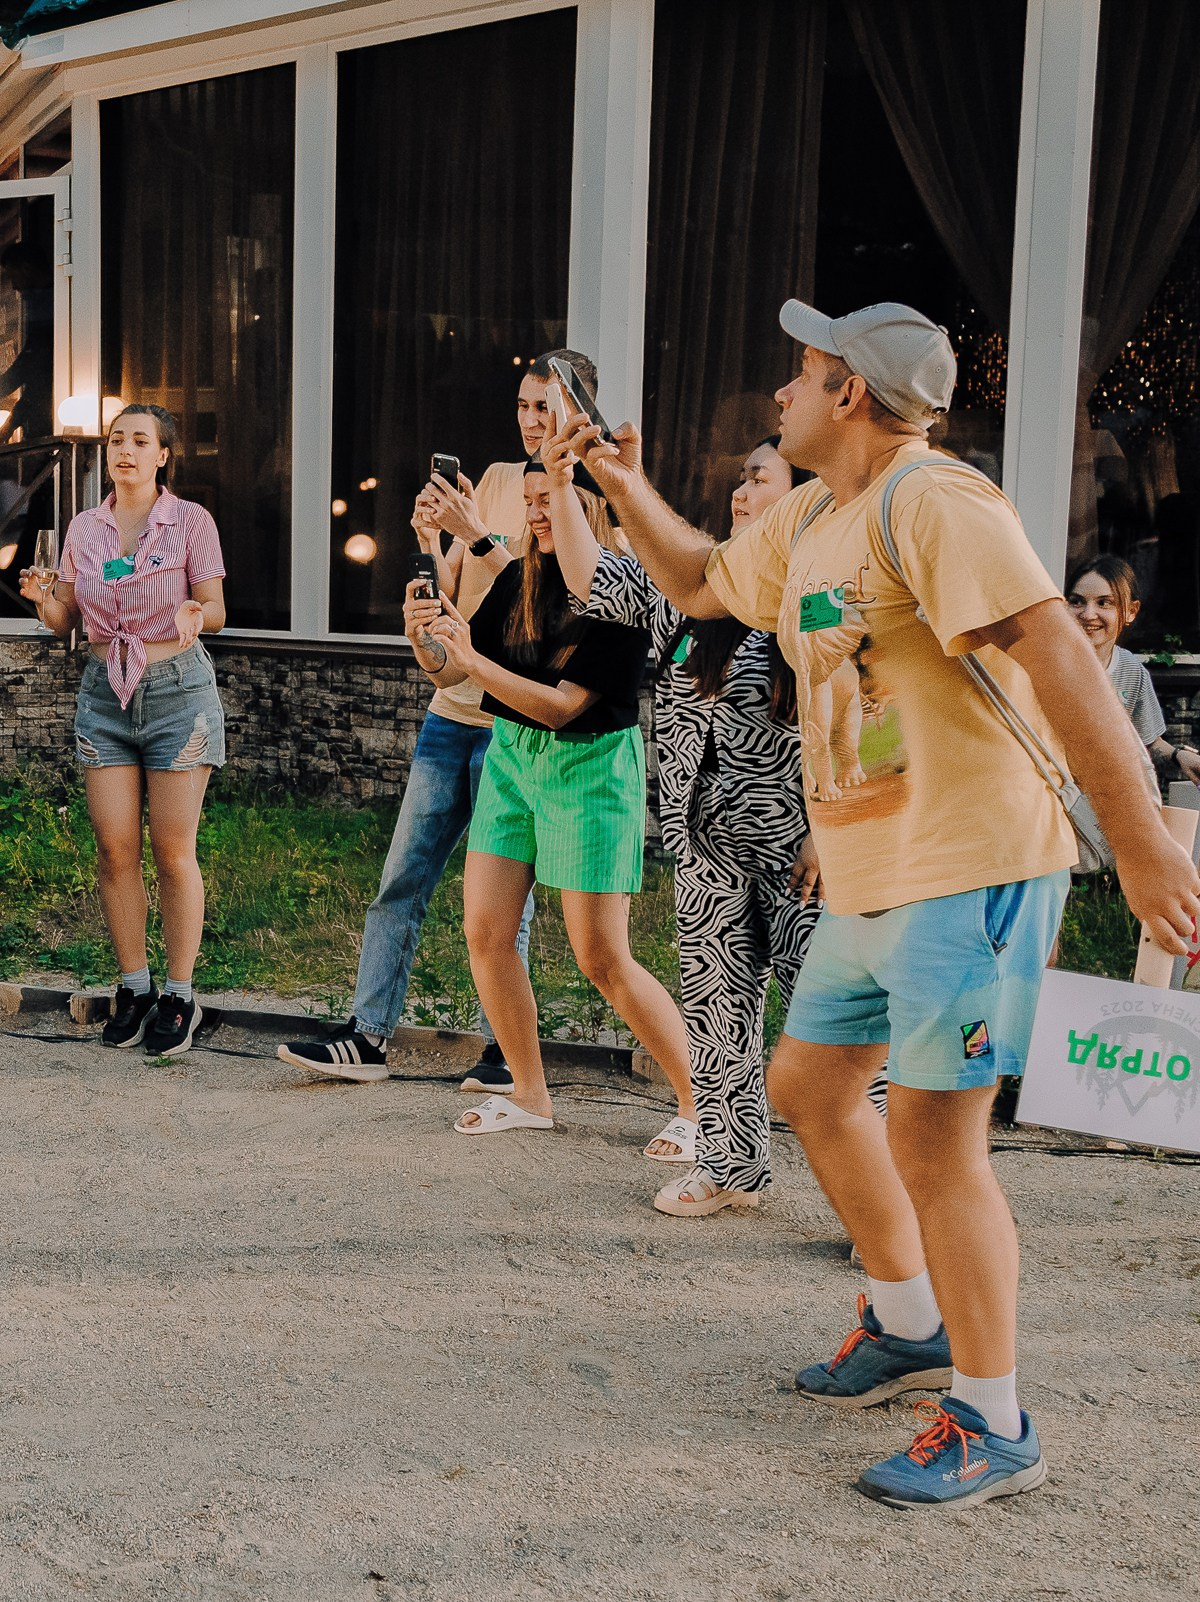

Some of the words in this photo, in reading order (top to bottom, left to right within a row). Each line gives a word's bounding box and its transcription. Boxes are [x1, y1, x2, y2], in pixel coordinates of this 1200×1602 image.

[1101, 1000, 1144, 1017] 2023
[1067, 1029, 1191, 1081] ОТРЯД
[950, 1457, 988, 1479] Columbia
